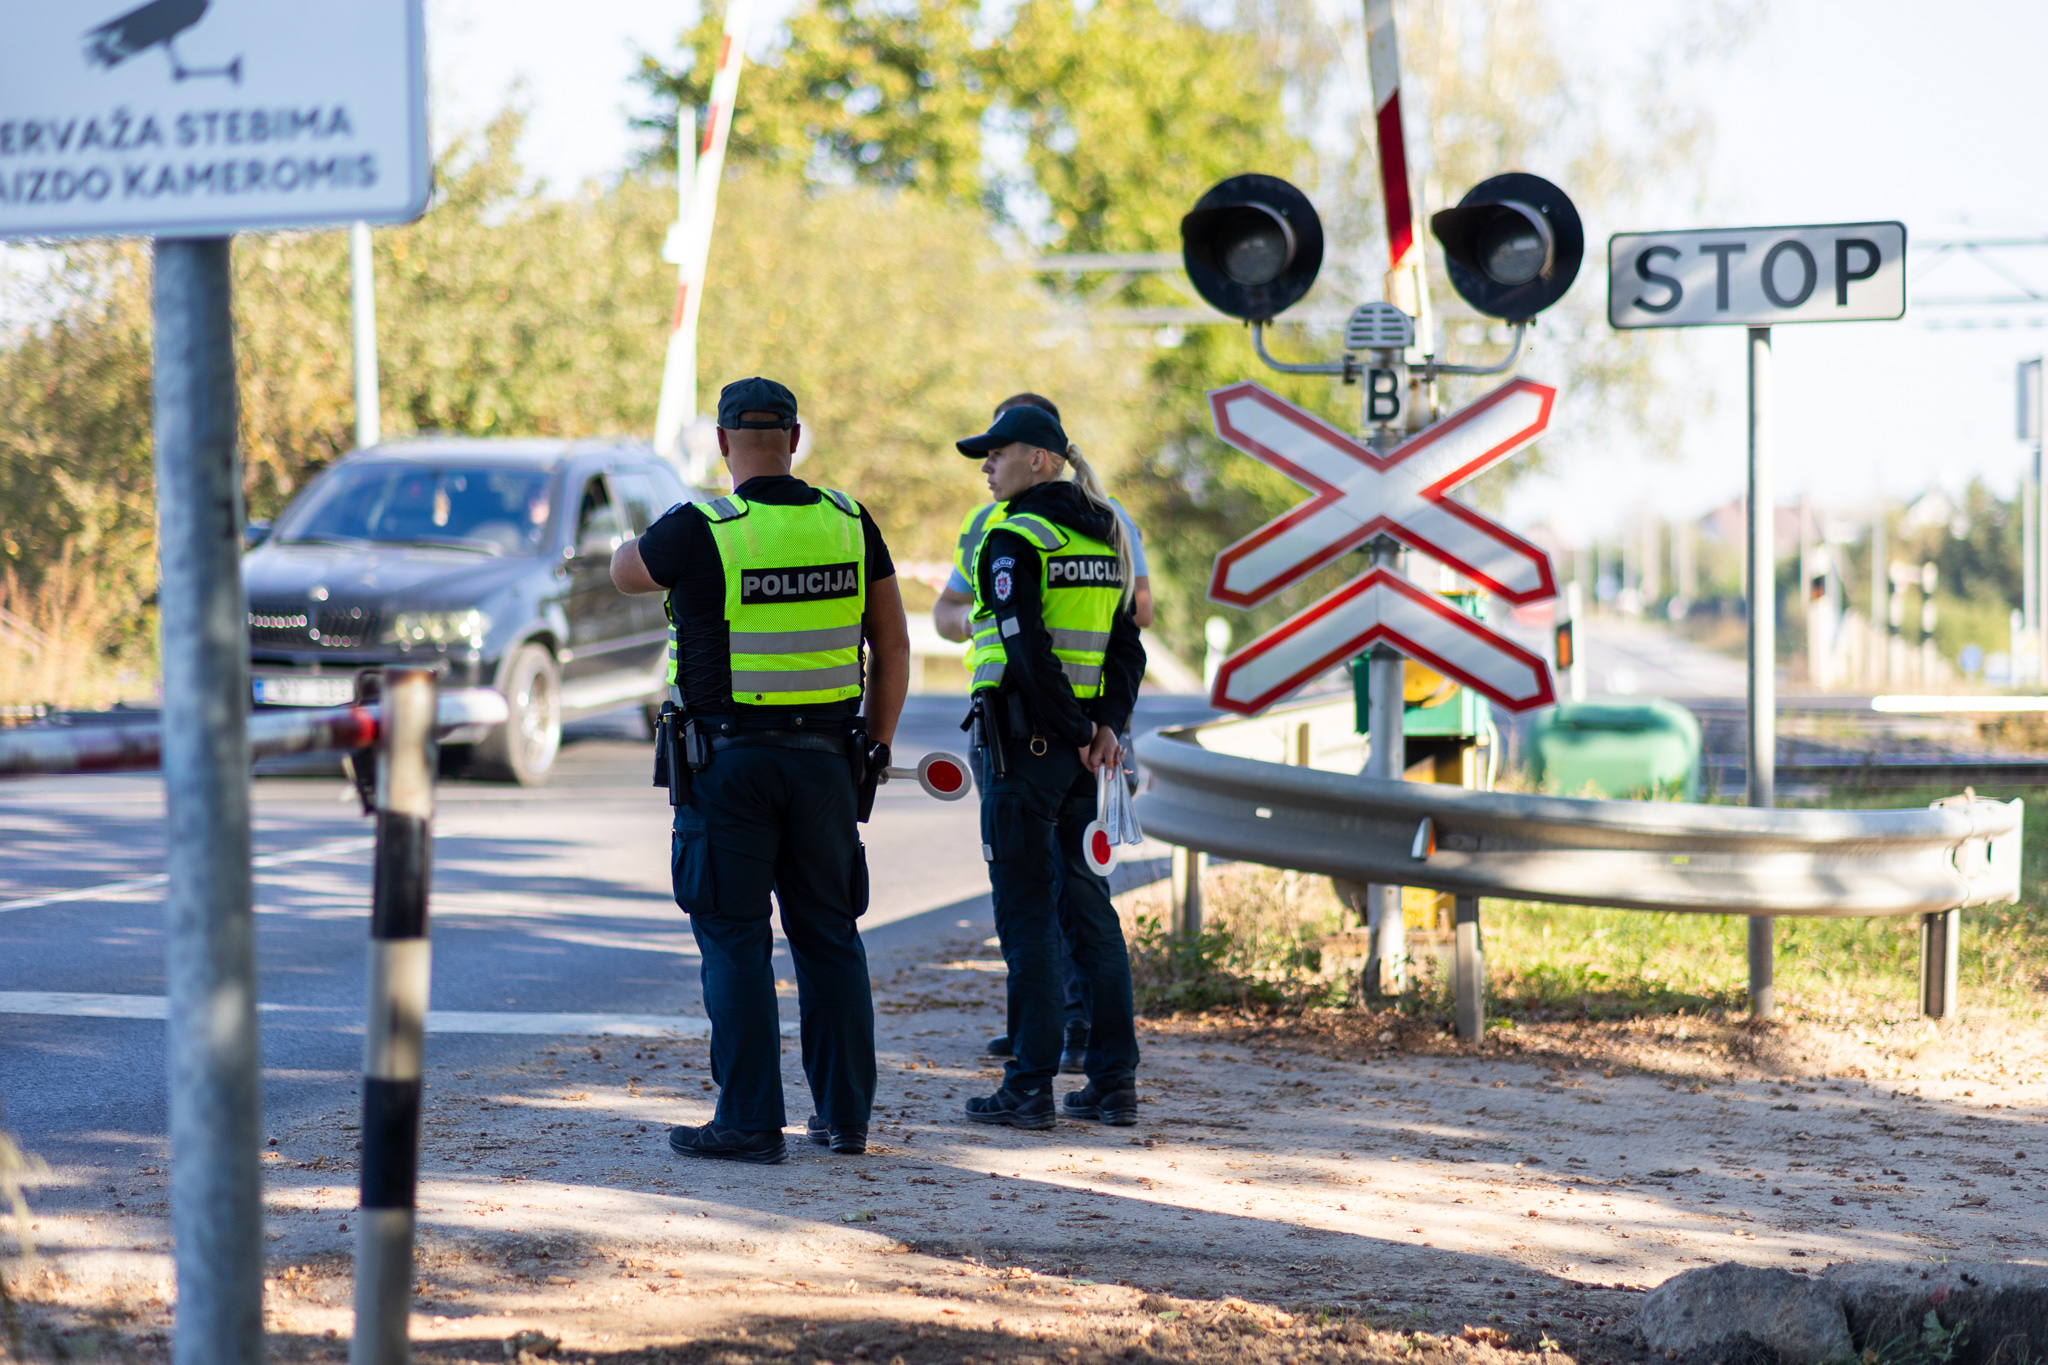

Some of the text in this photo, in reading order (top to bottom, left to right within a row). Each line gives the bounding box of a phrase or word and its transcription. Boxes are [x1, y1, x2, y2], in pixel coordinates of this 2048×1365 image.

[175, 104, 353, 148] STEBIMA
[123, 153, 378, 199] KAMEROMIS
[1632, 238, 1882, 314] STOP
[1368, 368, 1401, 422] B
[742, 569, 858, 597] POLICIJA
